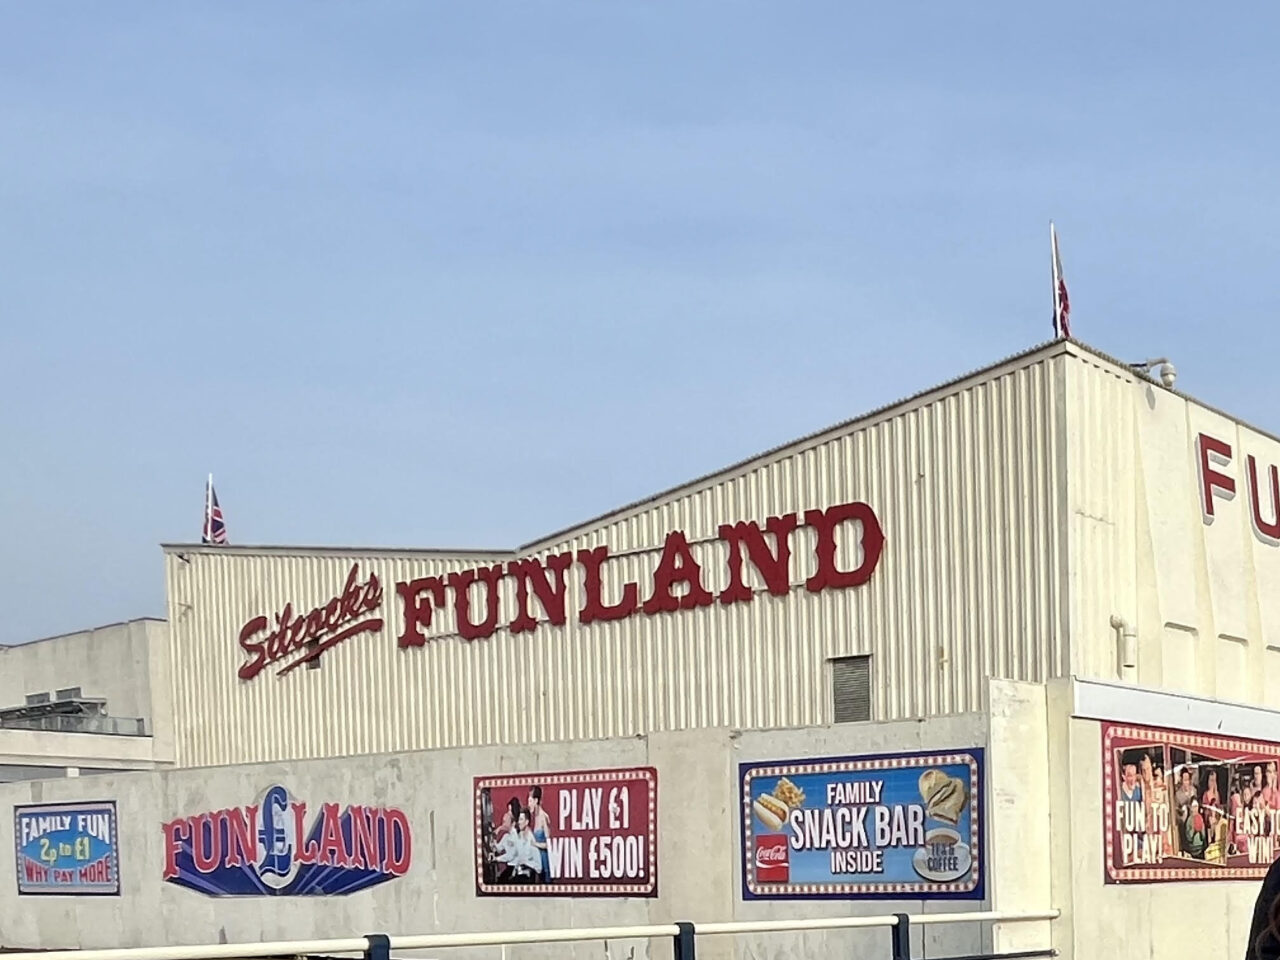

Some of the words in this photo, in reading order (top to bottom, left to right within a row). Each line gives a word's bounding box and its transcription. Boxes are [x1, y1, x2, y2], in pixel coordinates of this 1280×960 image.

[397, 501, 884, 648] FUNLAND
[827, 780, 883, 804] FAMILY
[559, 788, 603, 831] PLAY
[608, 786, 629, 829] £1
[1116, 801, 1147, 832] FUN
[1152, 802, 1170, 832] TO
[1236, 807, 1266, 834] EASY
[21, 815, 71, 846] FAMILY
[77, 814, 110, 845] FUN
[790, 808, 868, 850] SNACK
[875, 804, 925, 846] BAR
[547, 837, 583, 879] WIN
[588, 835, 645, 879] £500!
[831, 851, 883, 874] INSIDE
[1123, 834, 1163, 864] PLAY!
[24, 857, 49, 883] WHY
[53, 868, 74, 883] PAY
[78, 853, 113, 883] MORE
